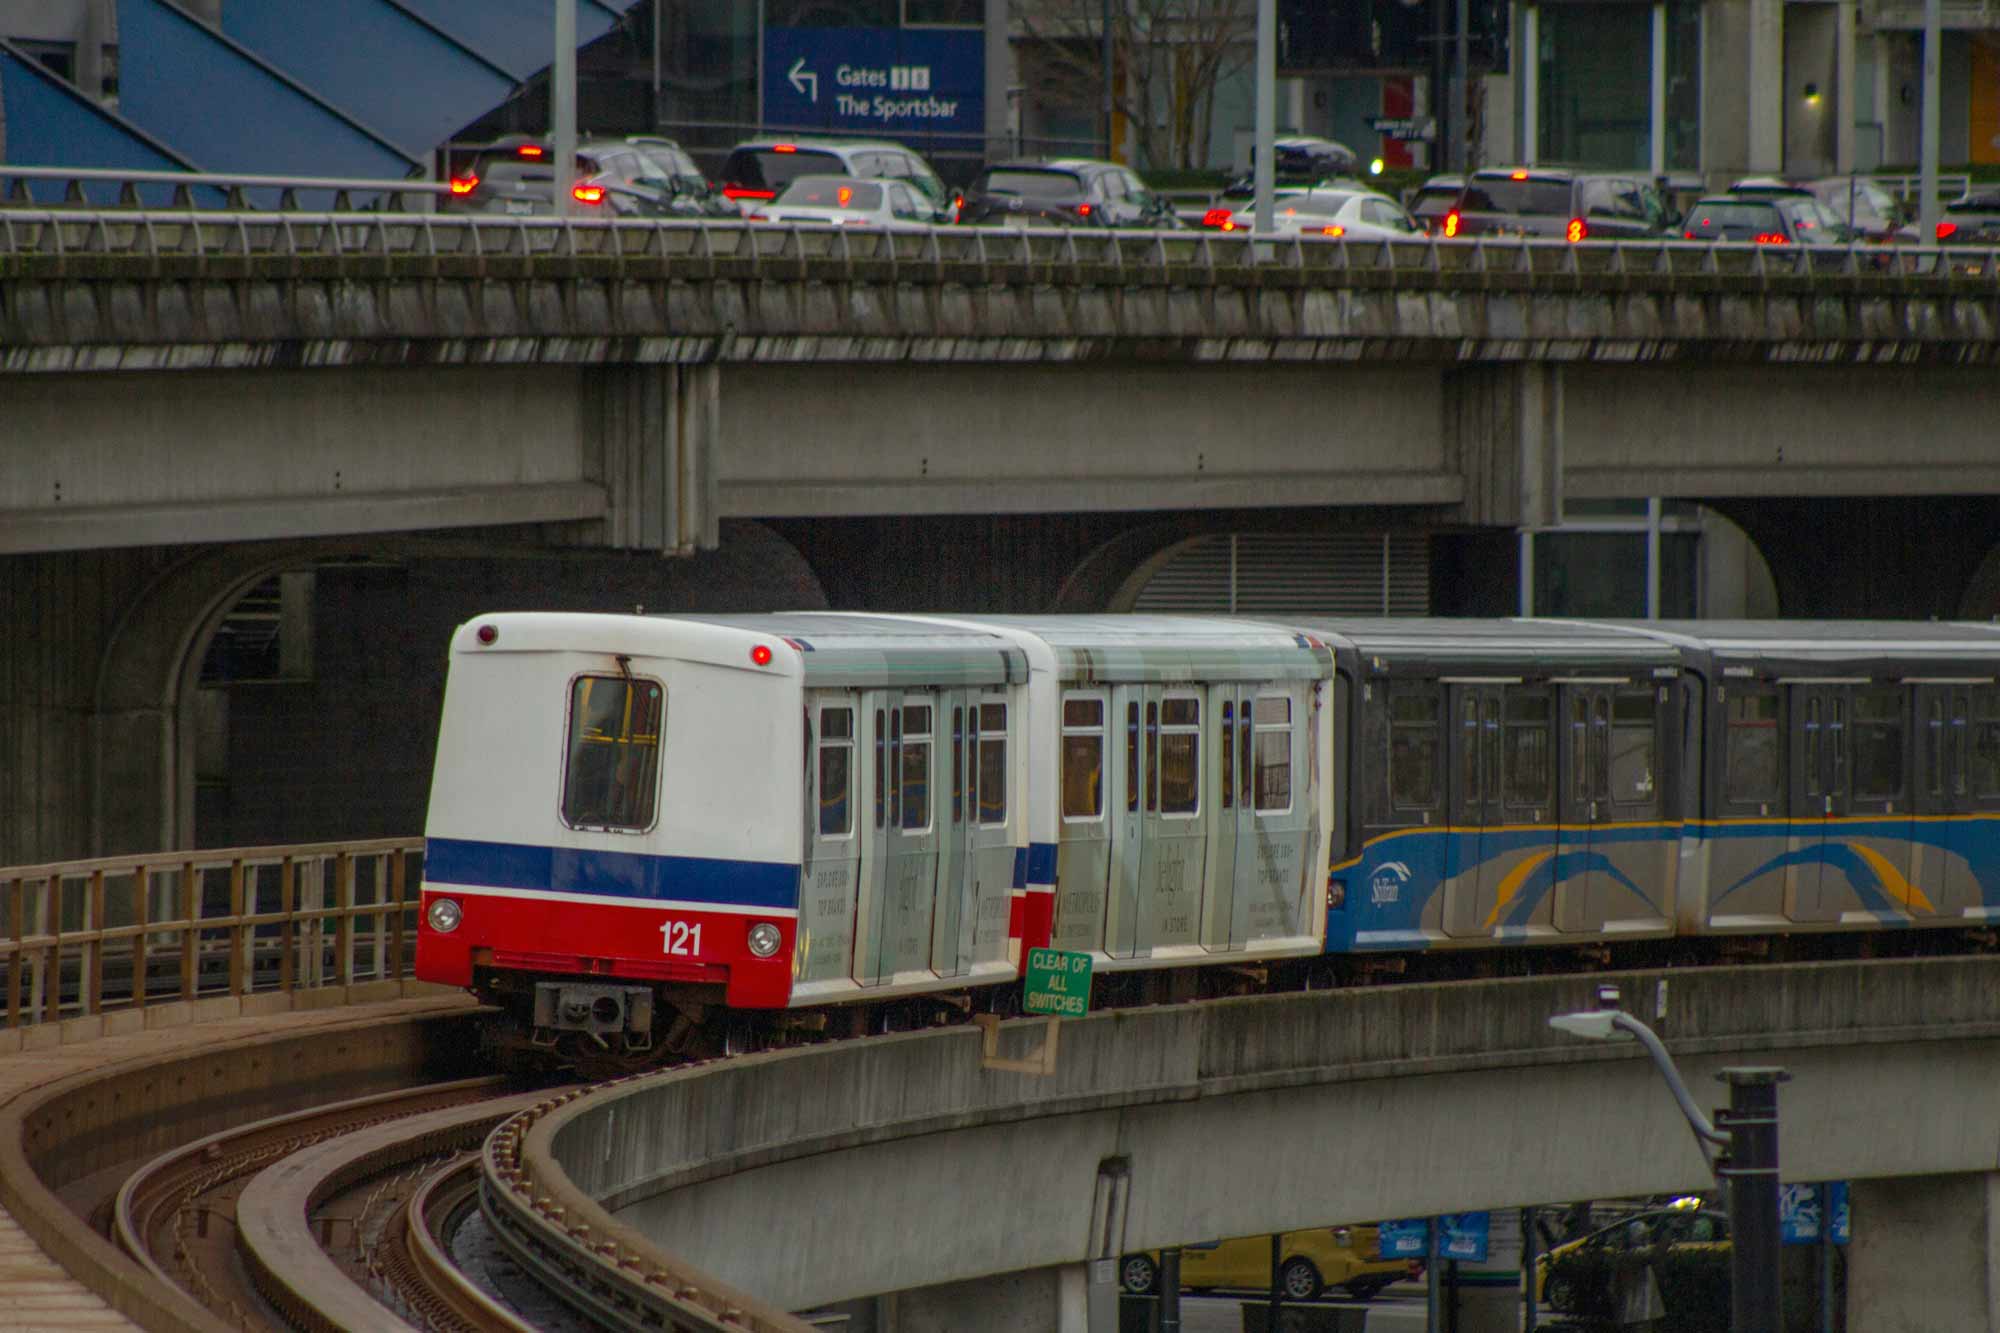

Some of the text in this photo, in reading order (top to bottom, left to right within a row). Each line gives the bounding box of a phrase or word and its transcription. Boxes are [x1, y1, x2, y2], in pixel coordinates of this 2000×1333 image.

[836, 65, 887, 87] Gates
[837, 96, 958, 122] The Sportsbar
[659, 920, 701, 956] 121
[1033, 952, 1089, 974] CLEAR OF
[1048, 974, 1067, 992] ALL
[1028, 991, 1084, 1013] SWITCHES
